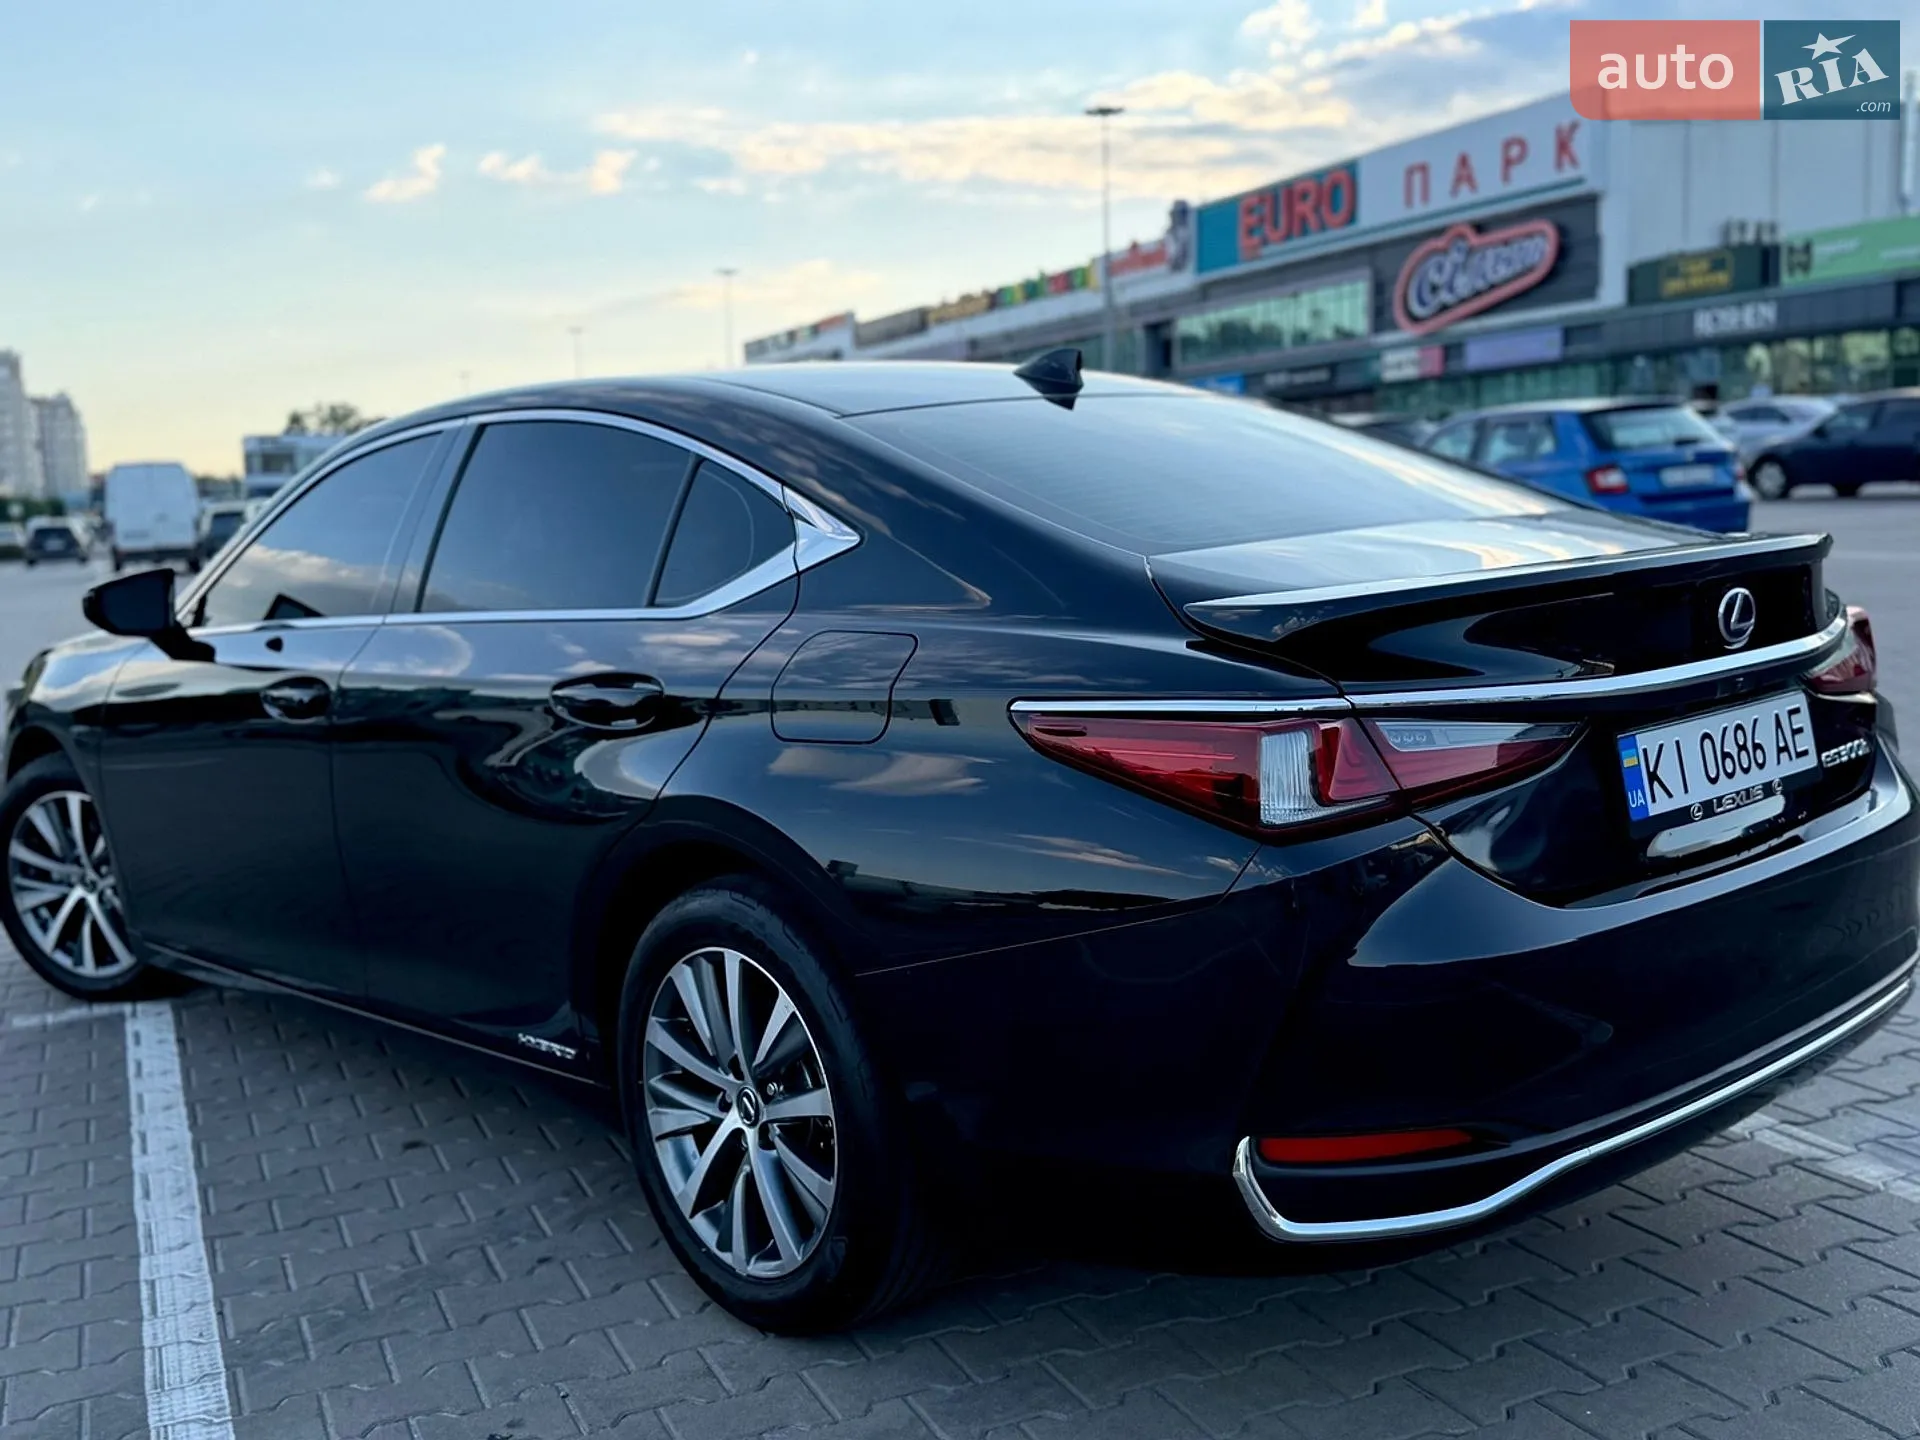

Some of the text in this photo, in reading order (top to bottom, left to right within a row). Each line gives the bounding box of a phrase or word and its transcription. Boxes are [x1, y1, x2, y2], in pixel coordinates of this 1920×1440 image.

[1404, 121, 1581, 208] ПАРК
[1238, 167, 1357, 254] EURO
[1641, 705, 1809, 804] KI 0686 AE
[1628, 791, 1646, 808] UA
[1713, 785, 1764, 814] LEXUS
